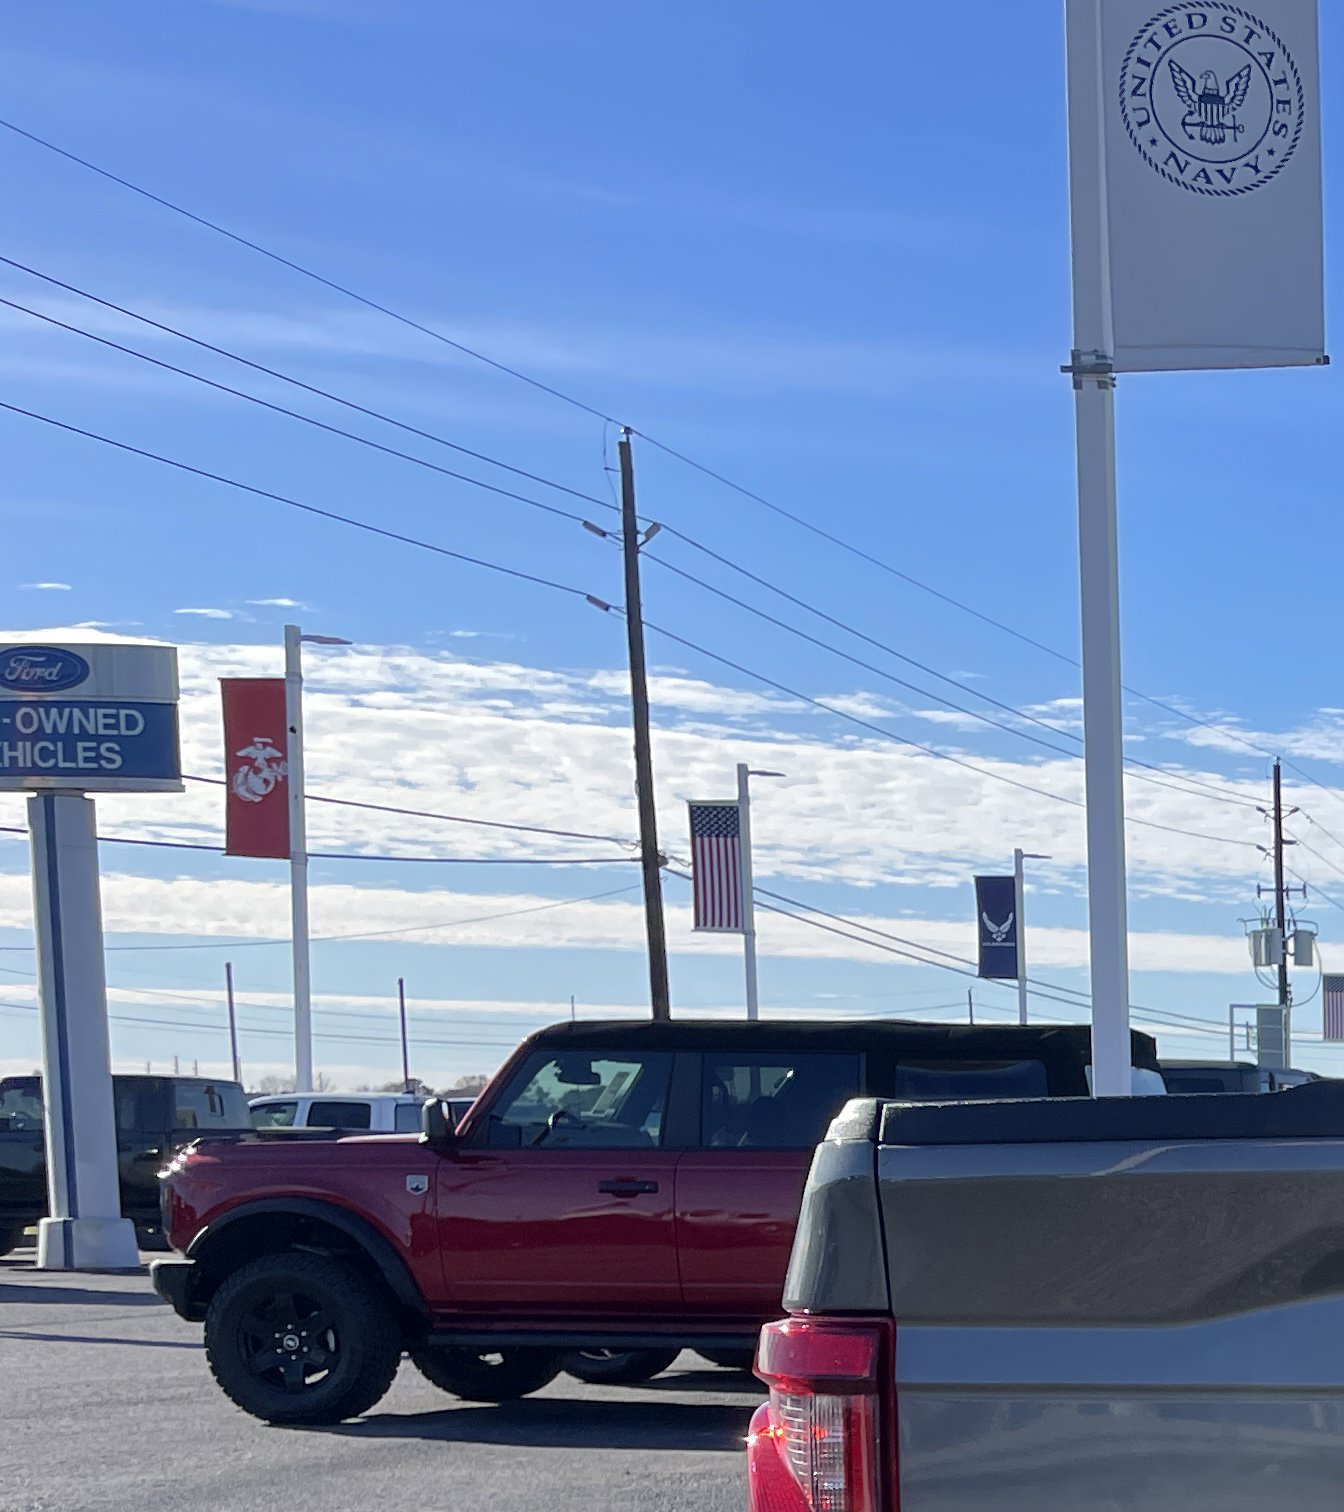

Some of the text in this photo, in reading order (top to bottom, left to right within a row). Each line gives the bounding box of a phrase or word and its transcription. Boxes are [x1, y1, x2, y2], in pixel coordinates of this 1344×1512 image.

[1131, 12, 1293, 140] UNITED STATES
[1162, 151, 1263, 186] NAVY
[4, 655, 63, 681] Ford
